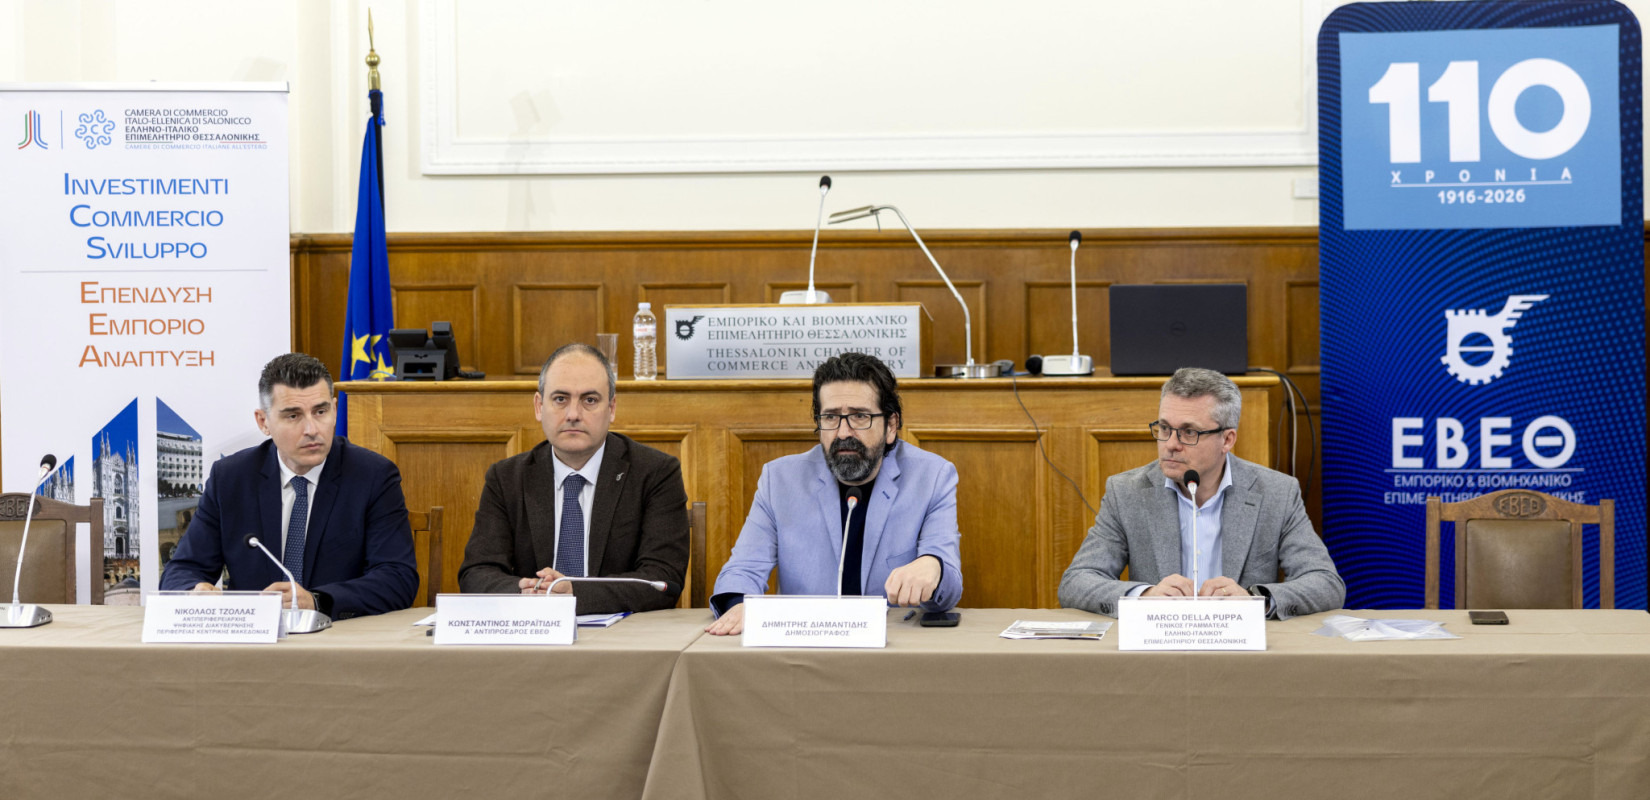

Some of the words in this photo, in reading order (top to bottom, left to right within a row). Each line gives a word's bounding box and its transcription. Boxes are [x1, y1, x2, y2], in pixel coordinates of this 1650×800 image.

[125, 109, 162, 117] CAMERA
[163, 109, 172, 117] DI
[173, 109, 228, 117] COMMERCIO
[1369, 58, 1591, 163] 110
[125, 117, 191, 125] ITALO-ELLENICA
[192, 117, 201, 125] DI
[203, 117, 252, 125] SALONICCO
[125, 133, 191, 141] ΕΠΙΜΕΛΗΤΗΡΙΟ
[192, 133, 260, 141] ΘΕΣΣΑΛΟΝΙΚΗΣ
[1438, 189, 1526, 204] 1916-2026
[707, 316, 776, 327] ΕΜΠΟΡΙΚΟ
[783, 316, 806, 326] ΚΑΙ
[812, 315, 907, 325] ΒΙΟΜΗΧΑΝΙΚΟ
[707, 330, 804, 340] ΕΠΙΜΕΛΗΤΗΡΙΟ
[807, 329, 907, 339] ΘΕΣΣΑΛΟΝΙΚΗΣ
[707, 348, 806, 358] THESSALONIKI
[888, 347, 906, 357] OF
[707, 361, 788, 371] COMMERCE
[1392, 415, 1576, 469] ΕΒΕΘ
[1394, 475, 1464, 488] ΕΜΠΟΡΙΚΟ
[1467, 475, 1475, 488] &
[1478, 474, 1571, 487] ΒΙΟΜΗΧΑΝΙΚΟ
[219, 608, 256, 616] ΤΖΟΛΛΑΣ
[512, 619, 561, 627] ΜΩΡΑΪΤΙΔΗΣ
